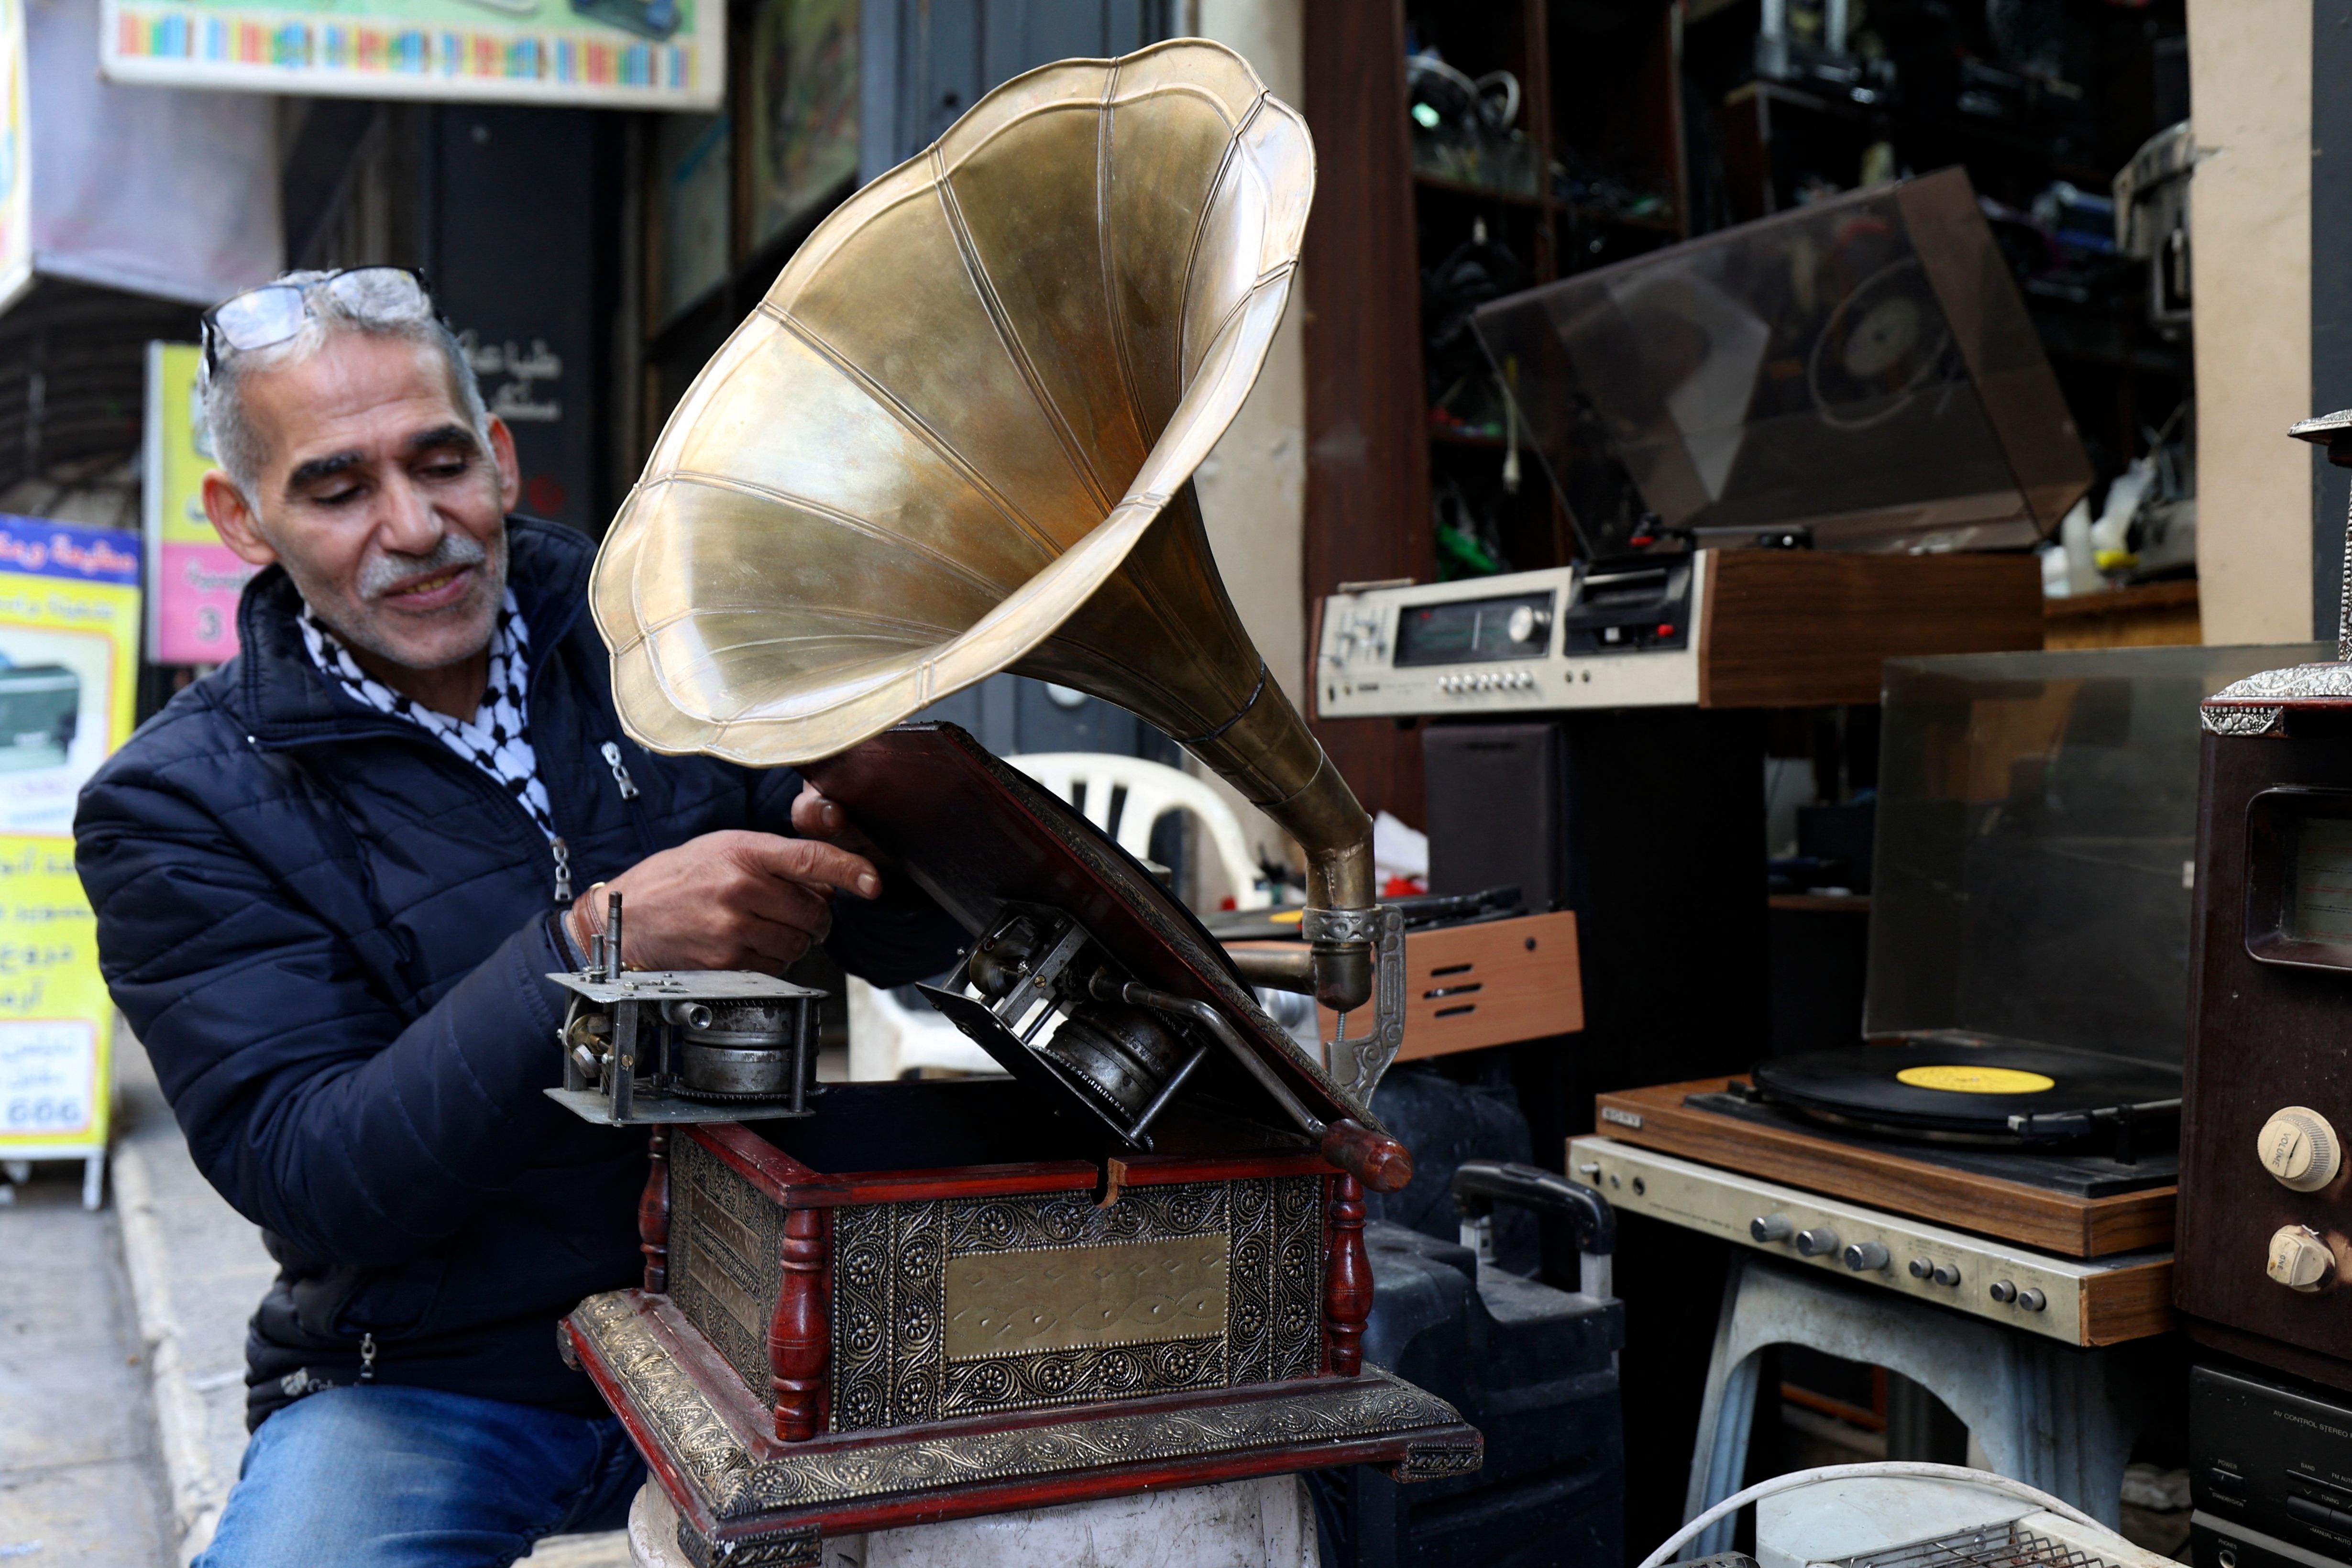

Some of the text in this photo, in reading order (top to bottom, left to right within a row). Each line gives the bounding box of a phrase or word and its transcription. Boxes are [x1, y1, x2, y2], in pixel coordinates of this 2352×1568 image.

[2272, 1132, 2291, 1168] VOLUME
[2277, 1252, 2286, 1270] ONE
[2284, 1413, 2318, 1428] CONTROL
[2319, 1424, 2348, 1438] STEREO
[2218, 1458, 2238, 1471] POWER
[2300, 1462, 2316, 1472] BAND
[2321, 1494, 2340, 1505] TUNING
[2218, 1538, 2238, 1550] PHONES
[2312, 1527, 2352, 1546] MANUAL AUTO
